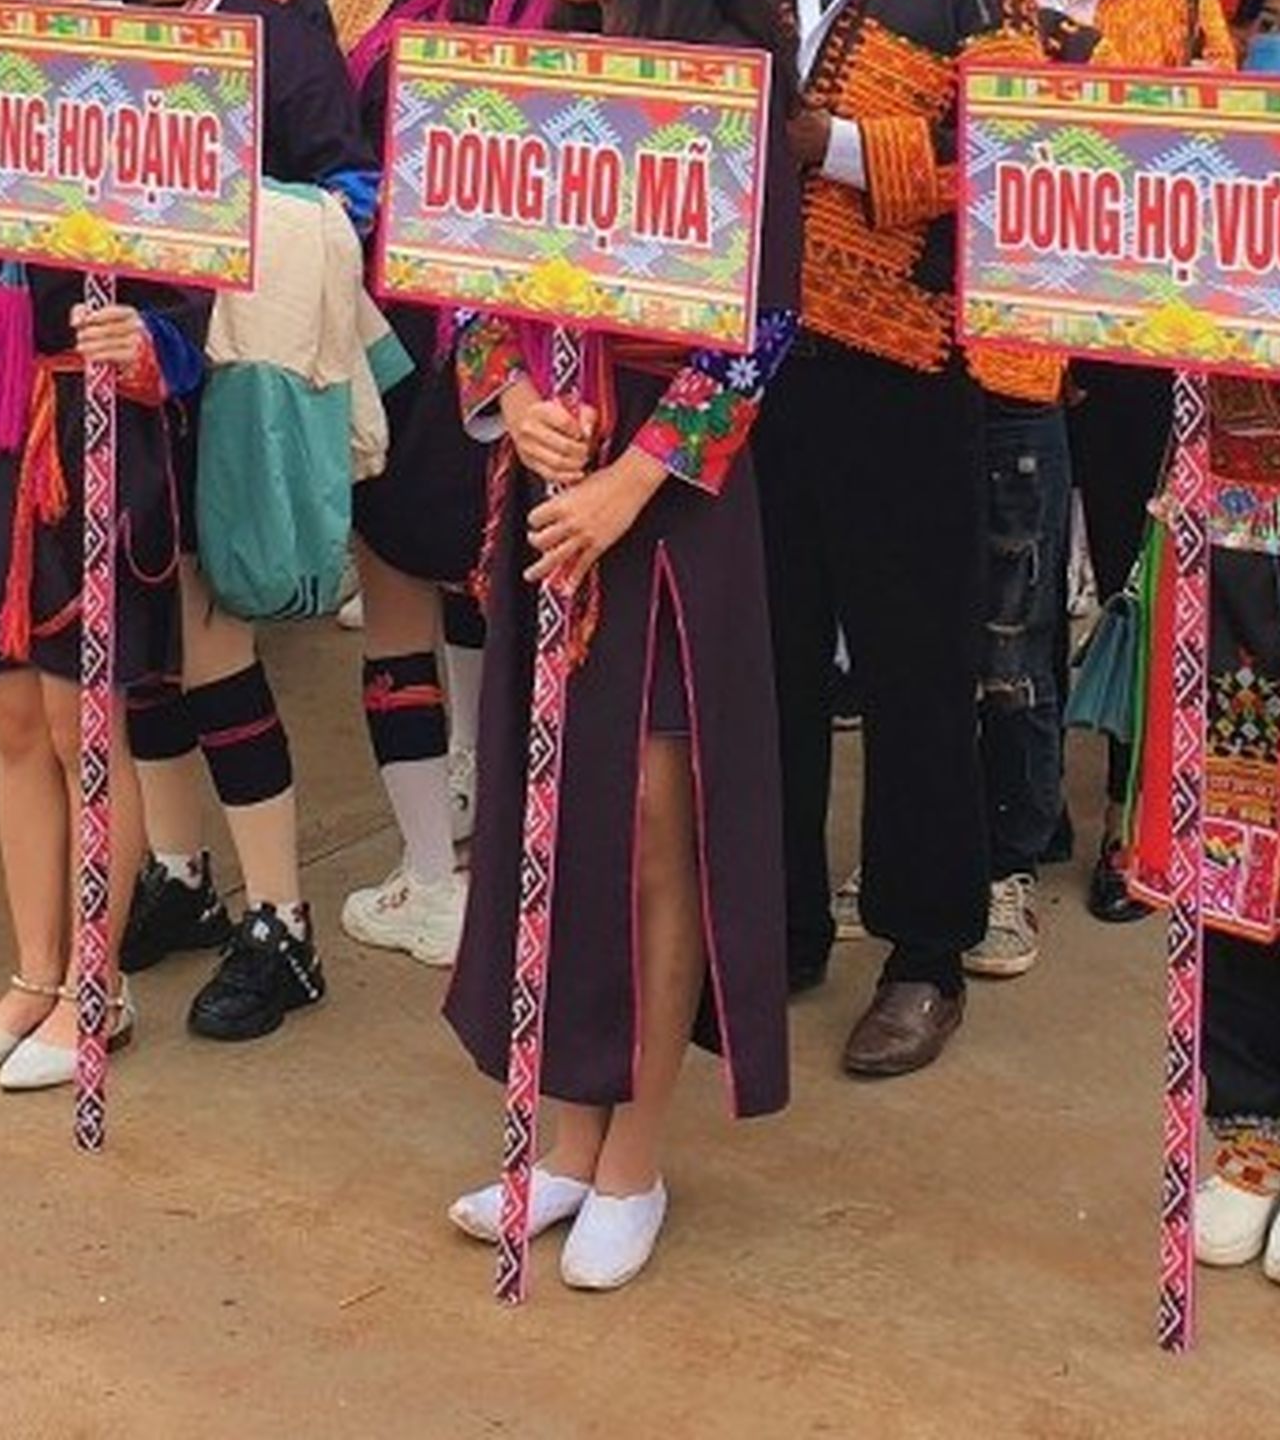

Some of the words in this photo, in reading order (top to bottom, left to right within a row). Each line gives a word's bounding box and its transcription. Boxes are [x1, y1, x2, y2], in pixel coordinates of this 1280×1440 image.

[58, 101, 106, 196] HỌ
[115, 93, 220, 203] ĐẶNG
[424, 112, 546, 219] DÒNG
[559, 146, 620, 249] HỌ
[634, 142, 709, 243] MÃ
[999, 147, 1121, 255] DÒNG
[1137, 176, 1198, 282] HỌ
